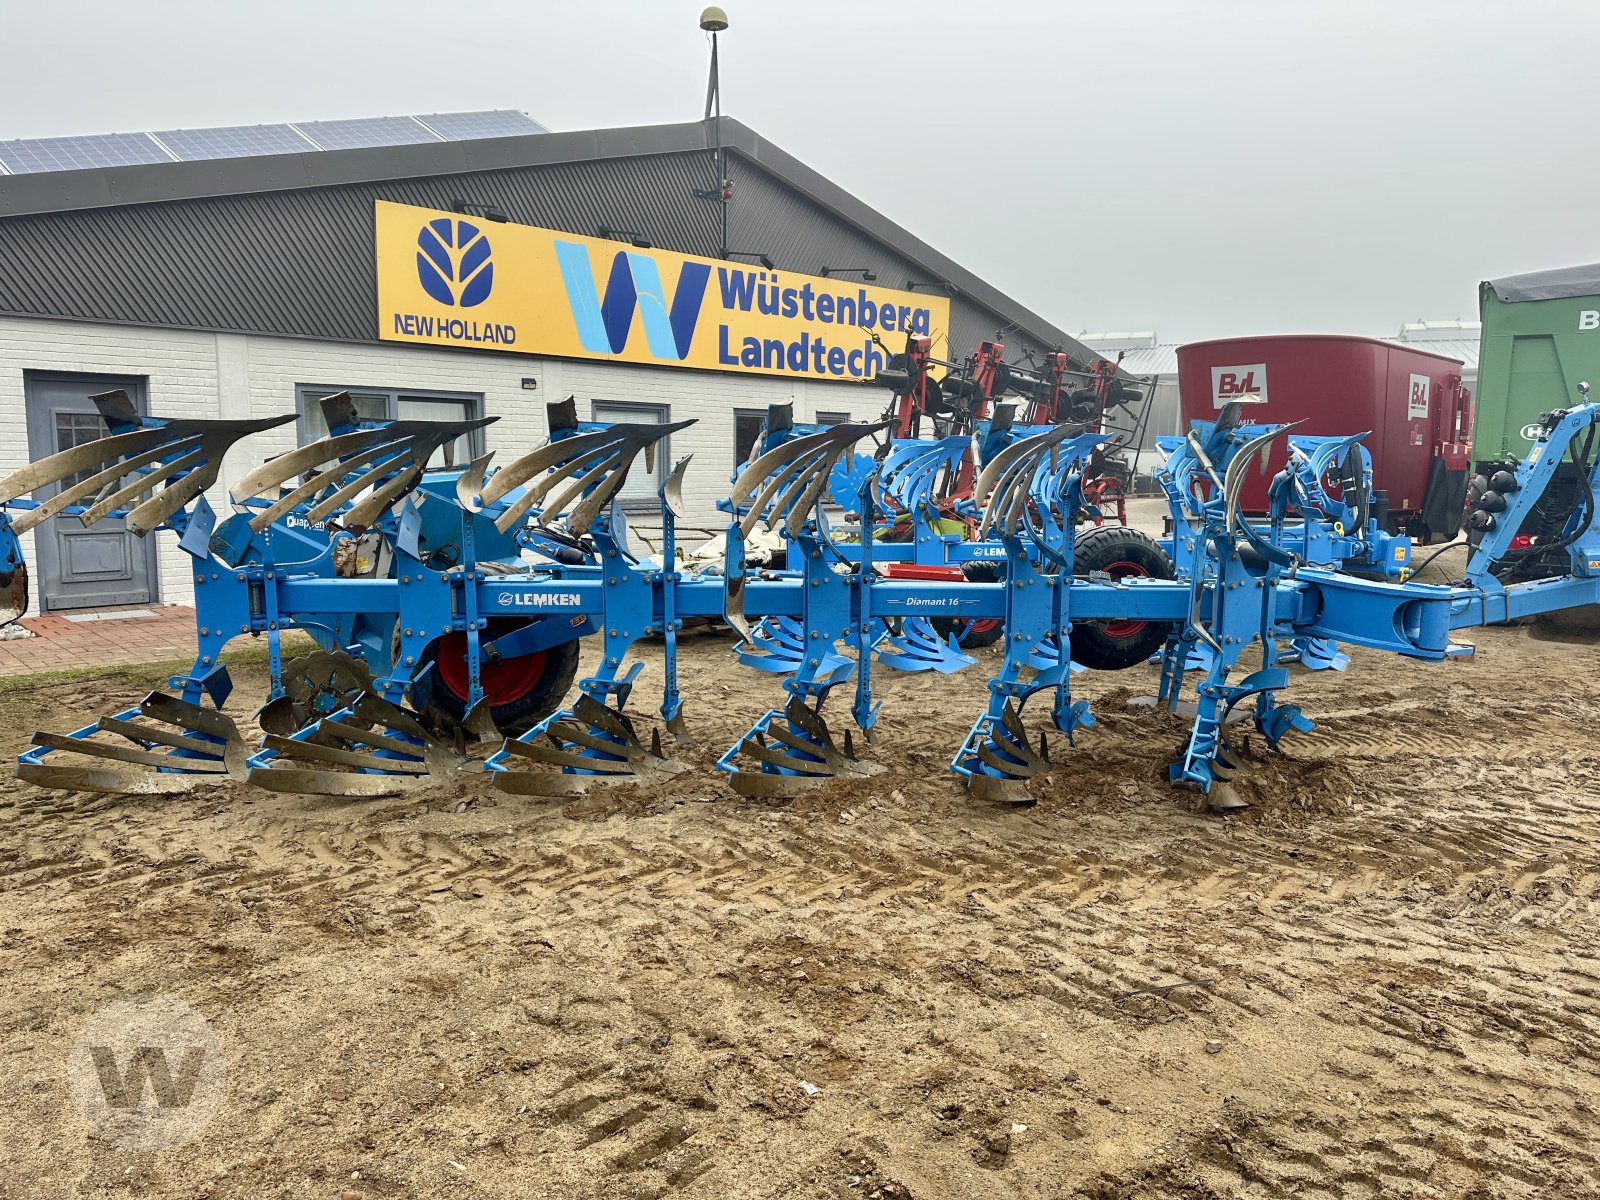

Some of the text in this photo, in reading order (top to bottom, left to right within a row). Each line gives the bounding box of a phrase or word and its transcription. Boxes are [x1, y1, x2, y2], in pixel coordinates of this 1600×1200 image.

[717, 266, 930, 337] Wüstenberg
[394, 313, 516, 345] NEW HOLLAND
[286, 515, 325, 530] Quapen
[515, 593, 581, 608] LEMKEN
[906, 597, 959, 606] Diamant 16
